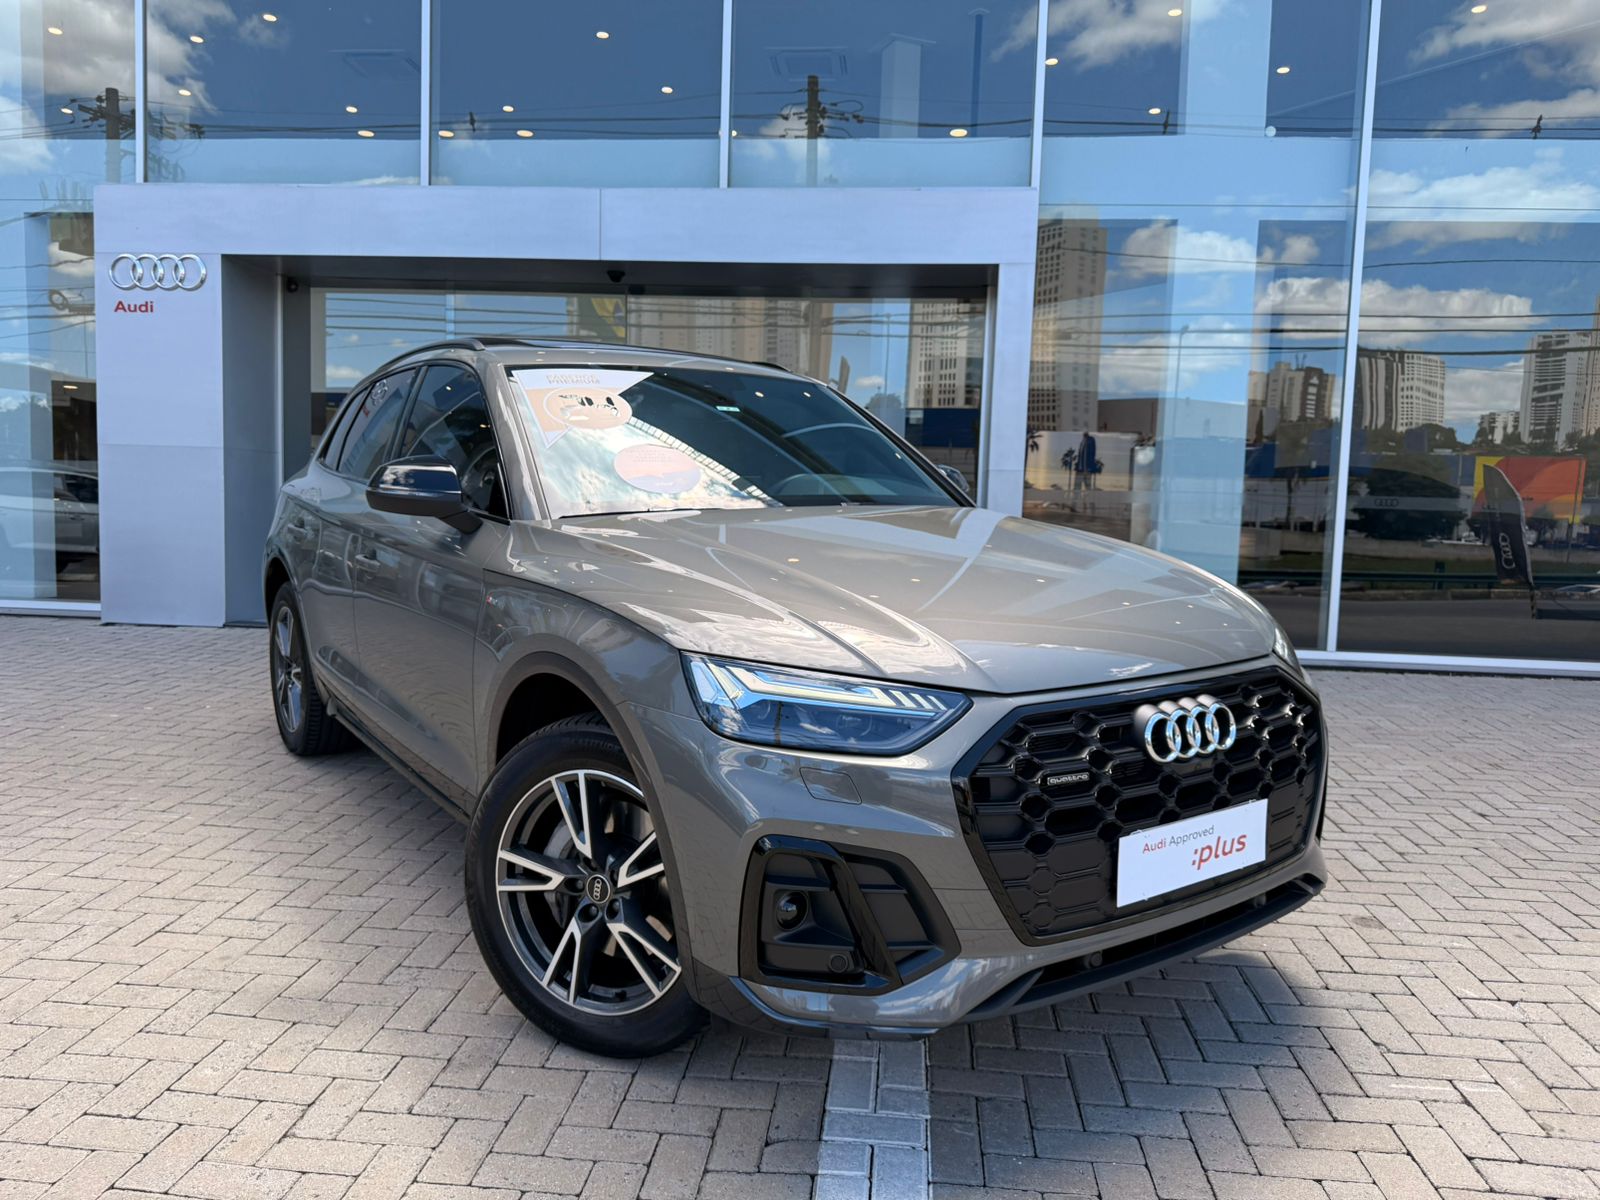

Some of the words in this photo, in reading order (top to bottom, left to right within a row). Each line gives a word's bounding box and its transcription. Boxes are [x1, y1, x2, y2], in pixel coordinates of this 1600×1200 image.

[114, 300, 154, 313] Audi
[1049, 774, 1088, 785] quattro
[1142, 839, 1167, 854] Audi
[1168, 825, 1215, 846] Approved
[1191, 834, 1248, 871] :plus
